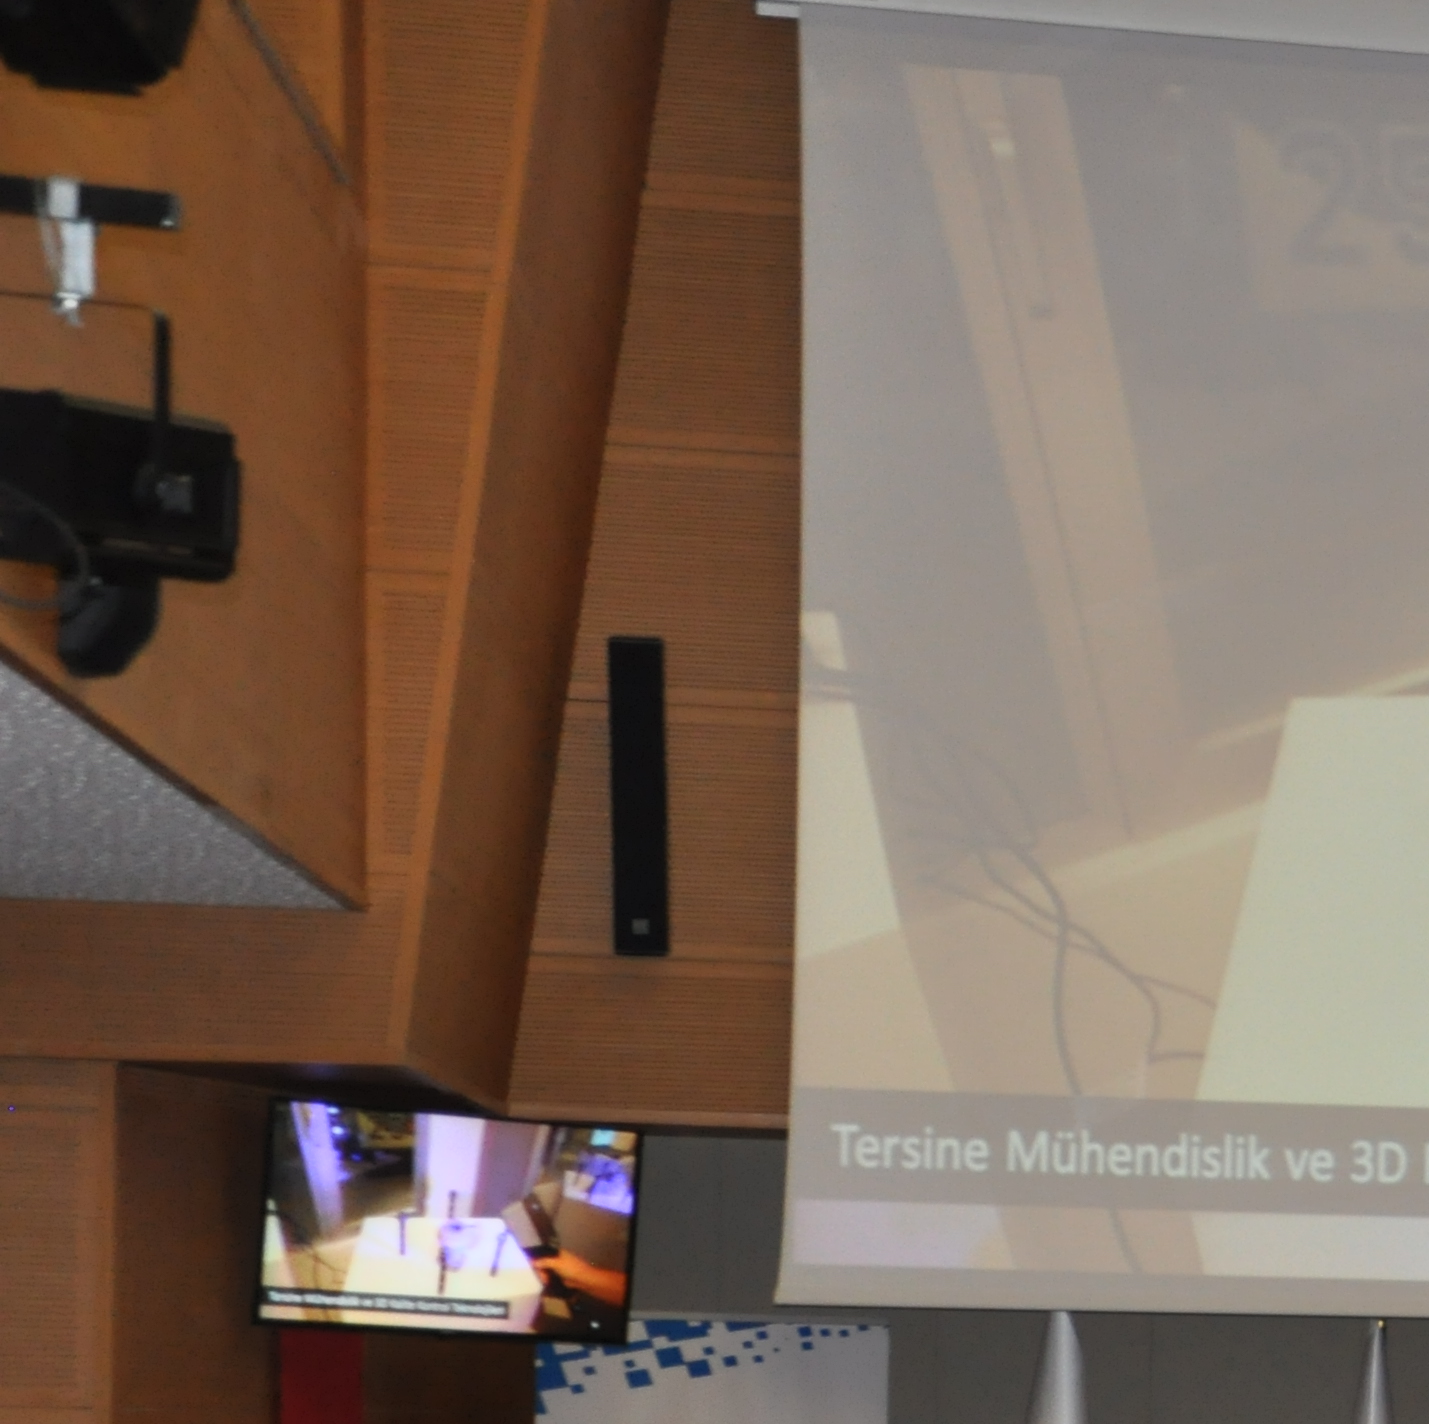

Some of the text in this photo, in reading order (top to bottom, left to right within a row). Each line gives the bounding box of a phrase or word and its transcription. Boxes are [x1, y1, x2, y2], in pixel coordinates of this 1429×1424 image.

[831, 1121, 991, 1172] Tersine
[1005, 1127, 1271, 1181] Mühendislik
[1285, 1147, 1335, 1183] ve
[1349, 1140, 1407, 1184] 3D
